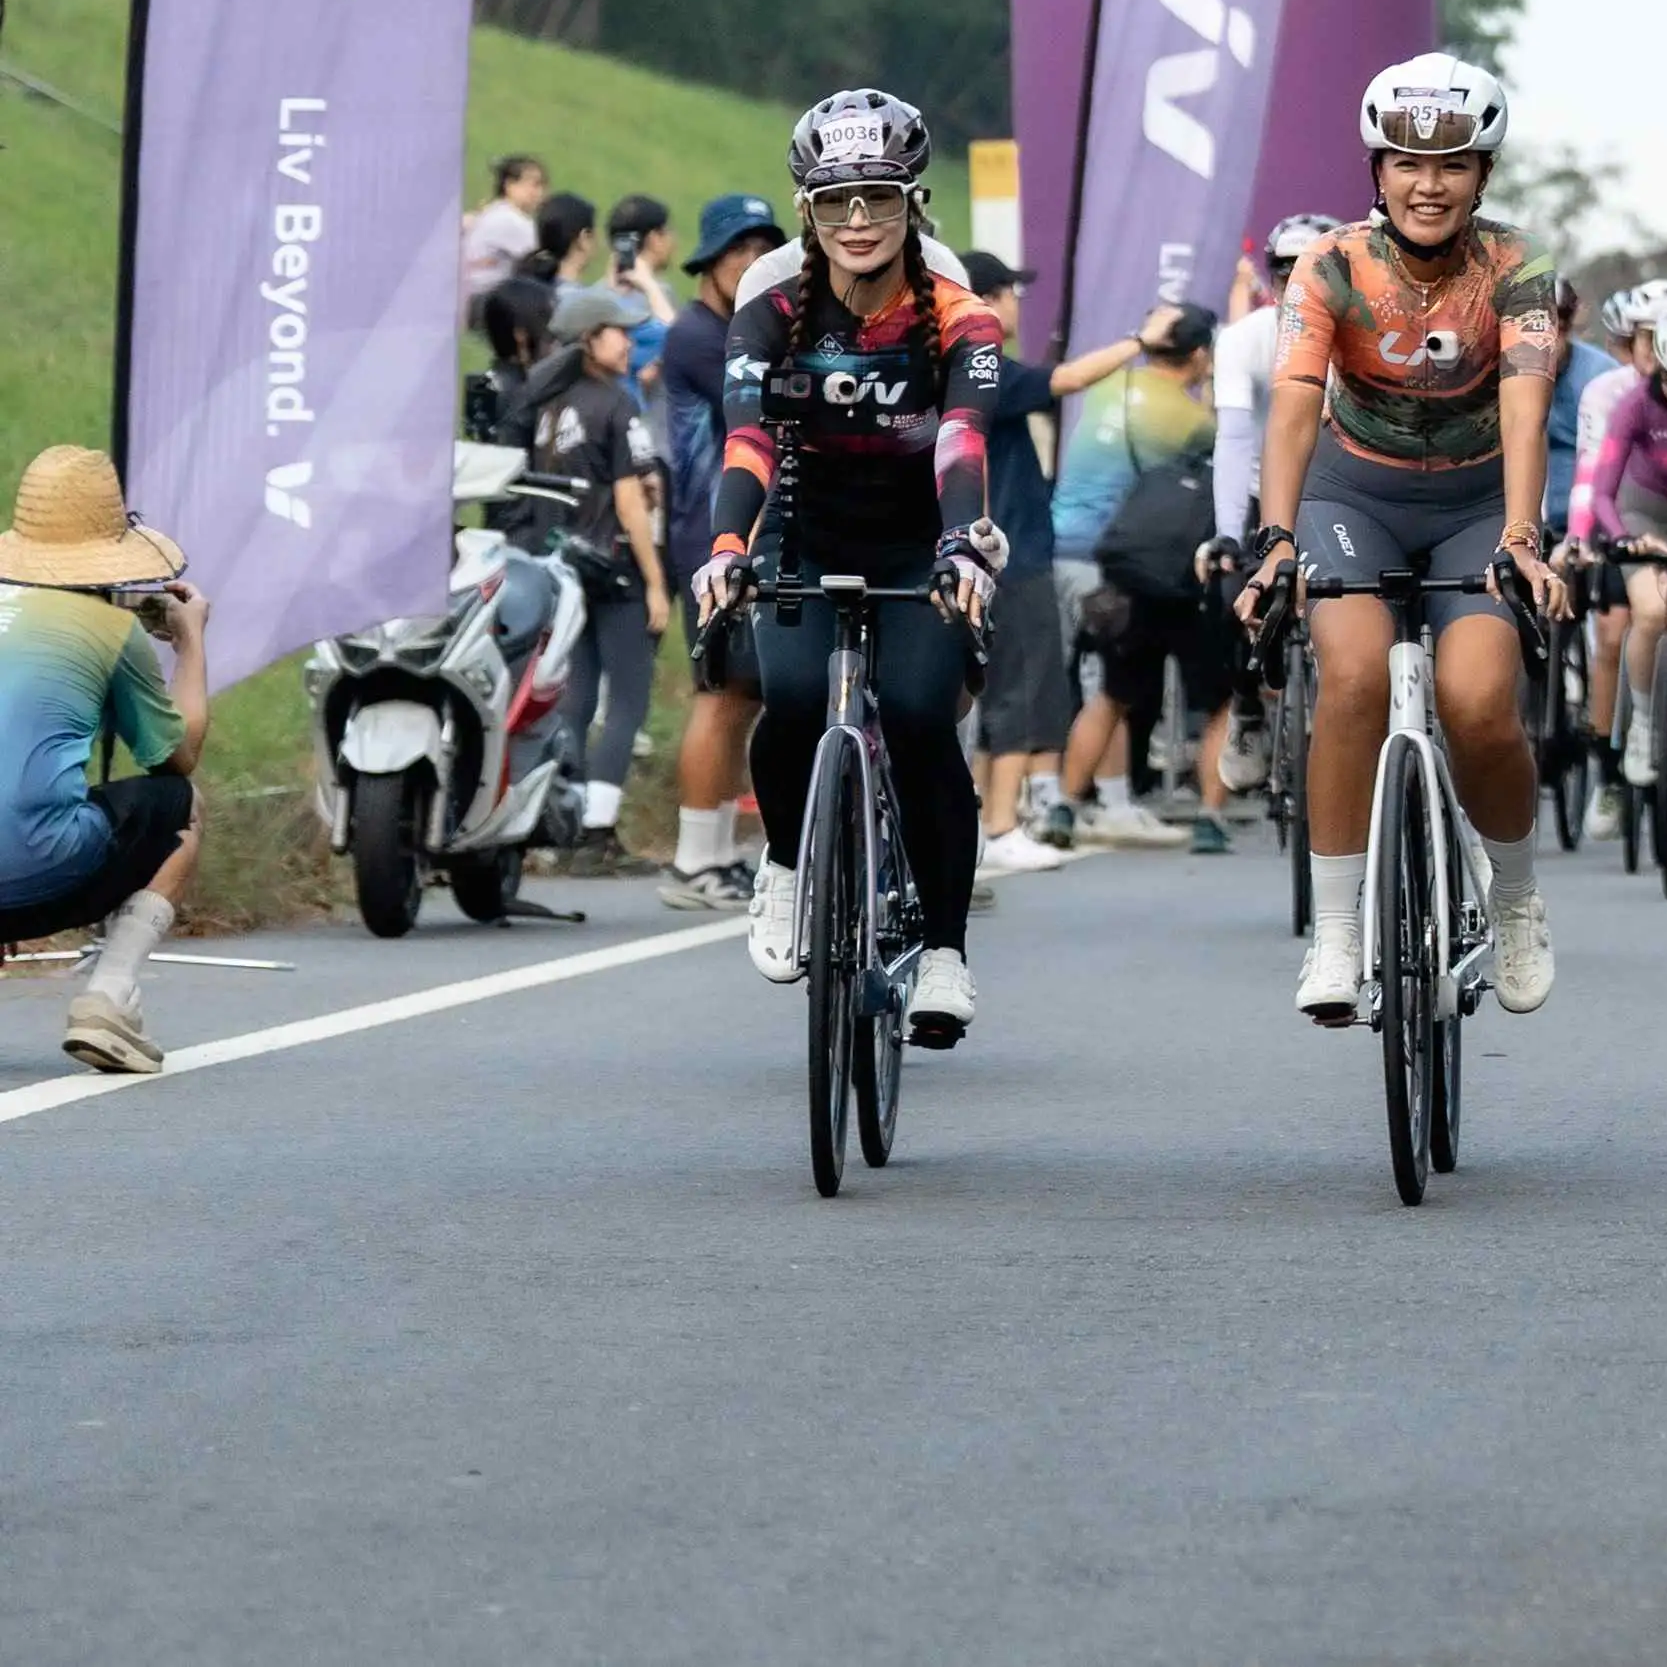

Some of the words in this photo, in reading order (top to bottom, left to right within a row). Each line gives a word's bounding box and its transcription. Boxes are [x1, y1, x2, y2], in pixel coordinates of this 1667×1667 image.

[280, 98, 326, 184] Liv
[823, 125, 879, 145] 10036
[261, 205, 322, 437] Beyond.
[968, 368, 993, 380] FOR
[971, 354, 998, 370] GO
[828, 370, 908, 405] iv
[1332, 523, 1356, 558] CADEX
